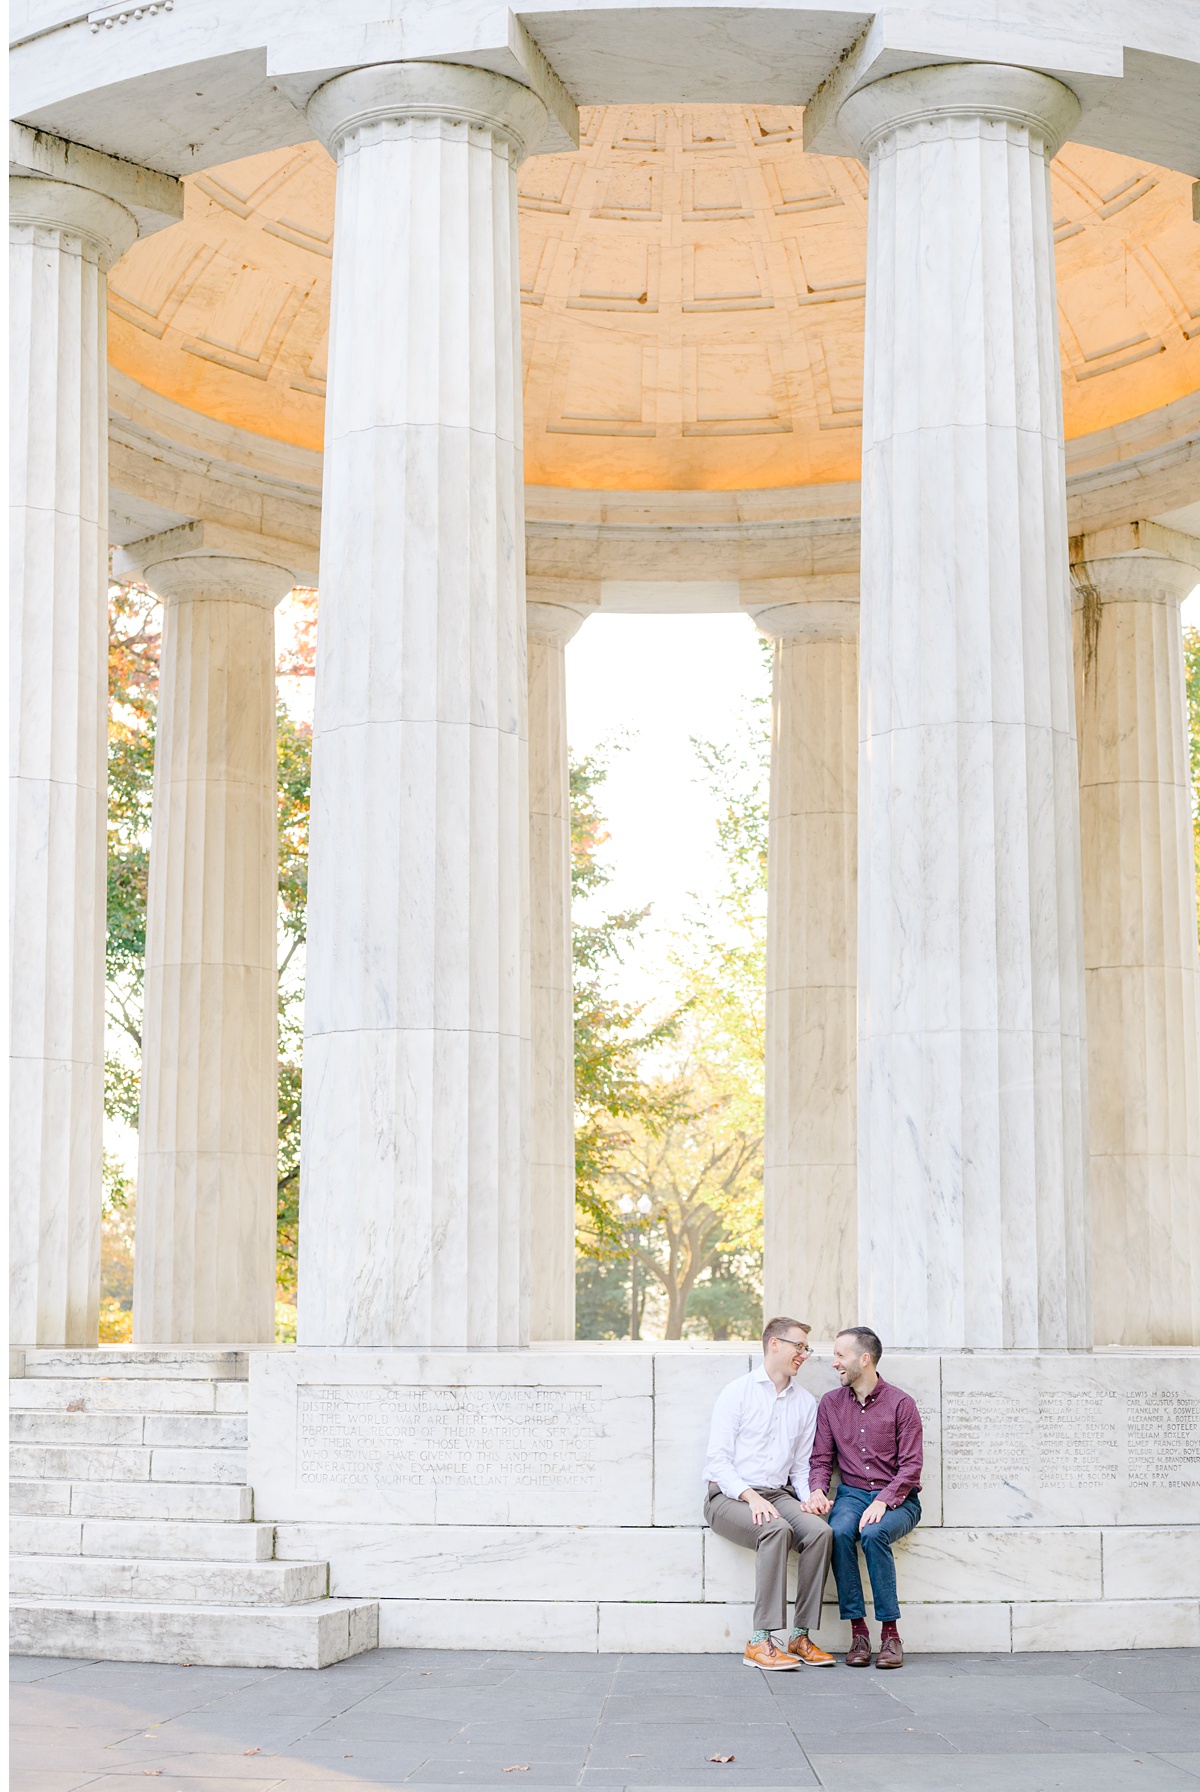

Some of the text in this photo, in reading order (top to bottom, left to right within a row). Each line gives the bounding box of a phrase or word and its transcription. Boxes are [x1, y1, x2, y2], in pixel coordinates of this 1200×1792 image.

[321, 1390, 596, 1401] THE NAMES OF THE MEN AND WOMEN FROM THE
[302, 1402, 595, 1413] DISTRICT OF COLUMBIA WHO GAVE THEIR LIVES
[302, 1414, 313, 1424] IN
[320, 1414, 341, 1424] THE
[348, 1414, 388, 1425] WORLD
[396, 1414, 420, 1425] WAR
[428, 1414, 449, 1425] ARE
[457, 1415, 485, 1425] HERE
[566, 1415, 580, 1425] AS
[302, 1426, 594, 1437] PERPETUAL RECORD OF THEIR PATRIOTIC SERVICE
[302, 1438, 594, 1449] TO THEIR COUNTRY THOSE WHO FELL AND THOSE
[302, 1449, 593, 1462] WHO SURVIVED HAVE GIVEN TO THIS AND TO FUTURE
[302, 1461, 380, 1472] GENERATIONS
[388, 1462, 402, 1472] AN
[411, 1462, 468, 1472] EXAMPLE
[477, 1462, 492, 1473] OF
[501, 1463, 531, 1473] HIGH
[1156, 1464, 1182, 1472] BRANDT
[301, 1473, 595, 1486] COURAGEOUS SACRIFICE AND GALLANT ACHIEVEMENT
